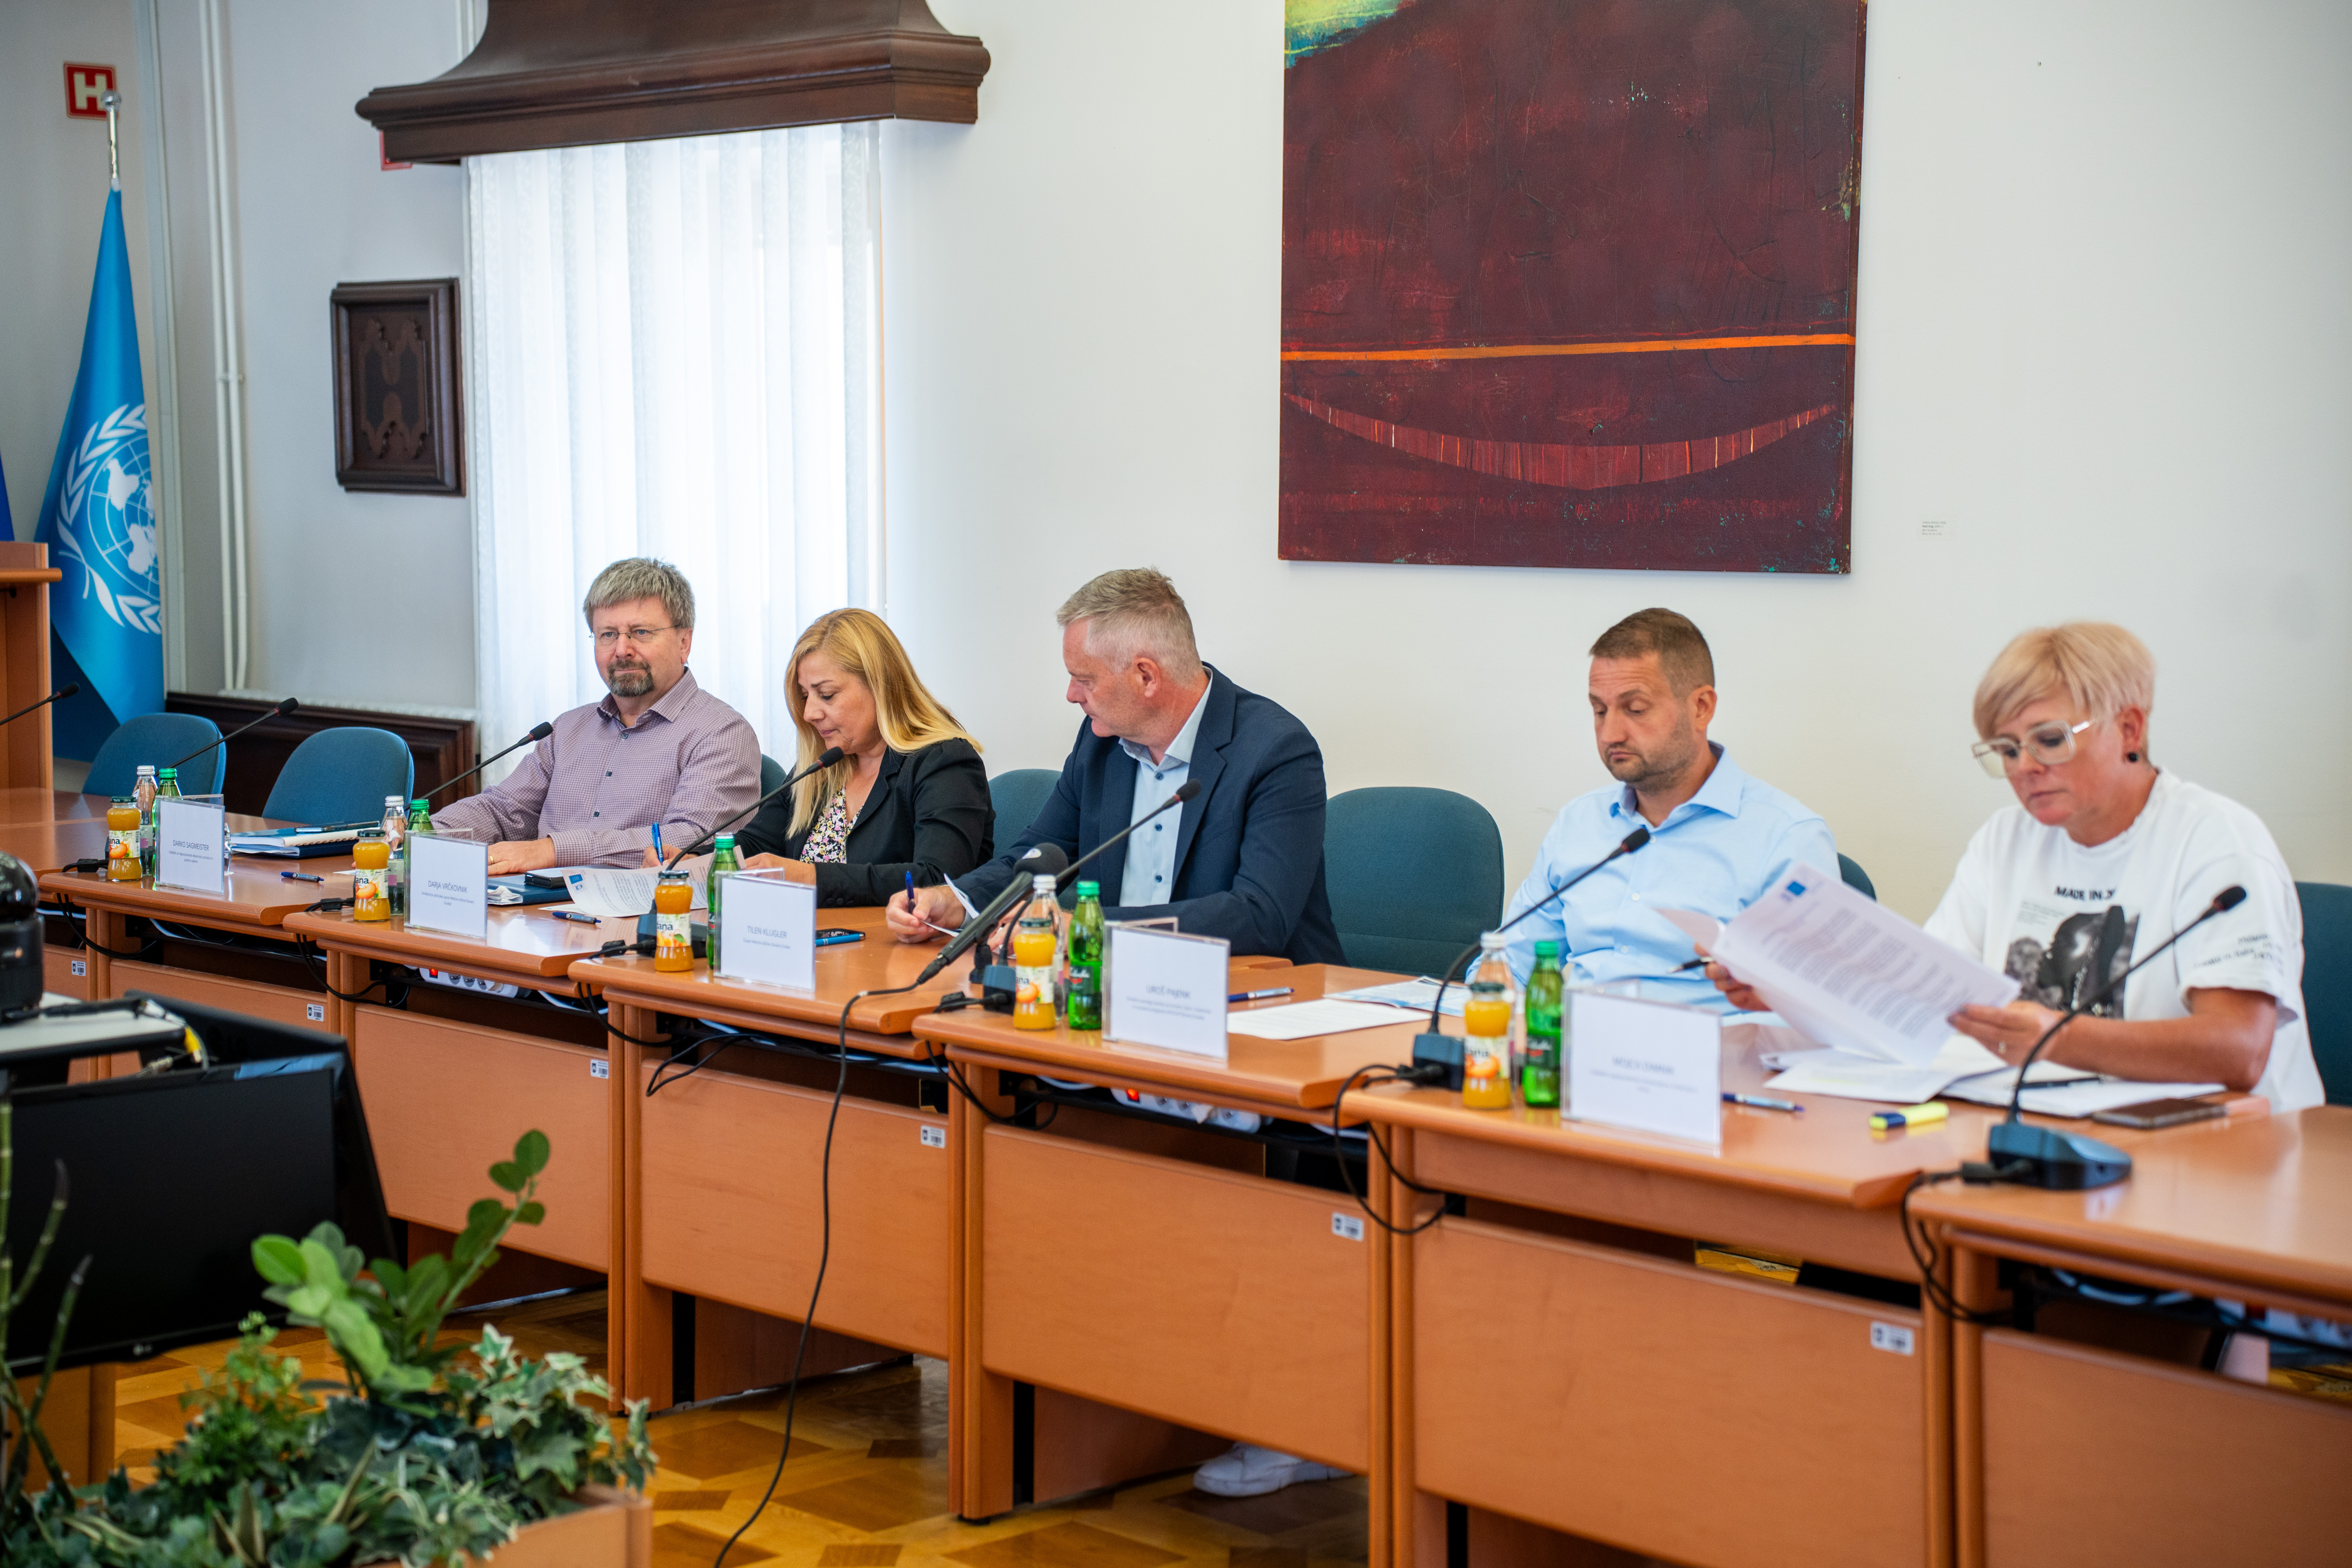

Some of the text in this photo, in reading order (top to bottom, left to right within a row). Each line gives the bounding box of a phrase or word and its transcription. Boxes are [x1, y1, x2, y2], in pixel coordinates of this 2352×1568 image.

[186, 842, 209, 851] SAGMEISTER
[428, 881, 467, 893] DARJA VRČKOVNIK
[747, 926, 787, 939] TILEN KLUGLER
